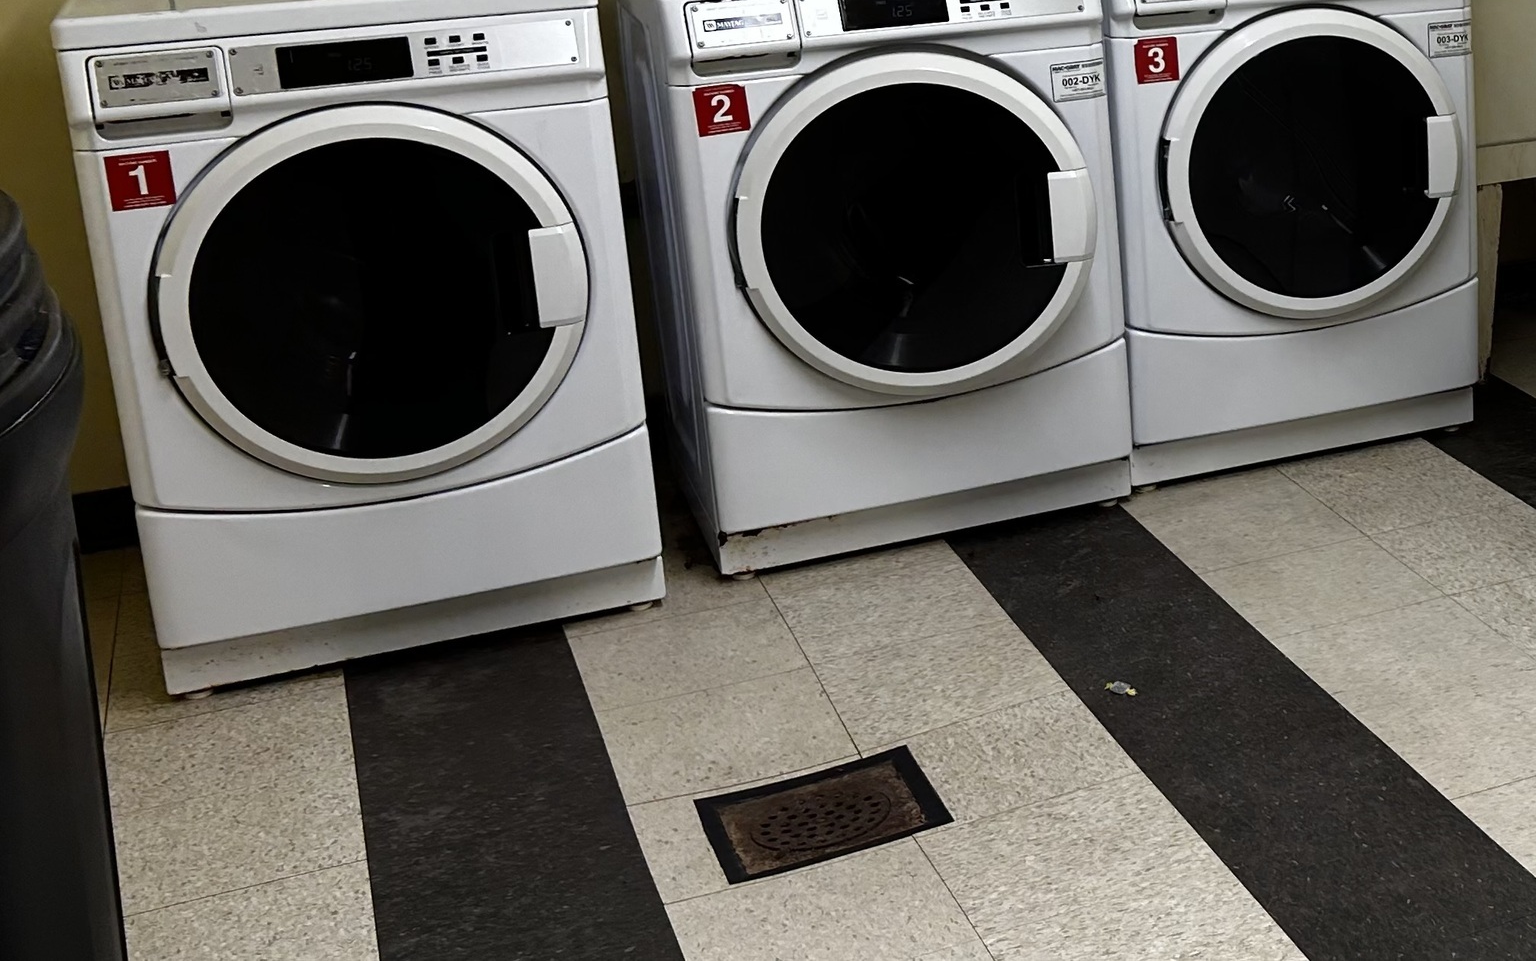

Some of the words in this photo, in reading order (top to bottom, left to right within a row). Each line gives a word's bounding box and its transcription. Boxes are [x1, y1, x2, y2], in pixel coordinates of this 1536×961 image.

[1437, 34, 1468, 44] 003-DYK
[1148, 47, 1165, 73] 3
[1062, 74, 1100, 86] 002-DYK
[711, 94, 733, 123] 2
[128, 165, 149, 195] 1
